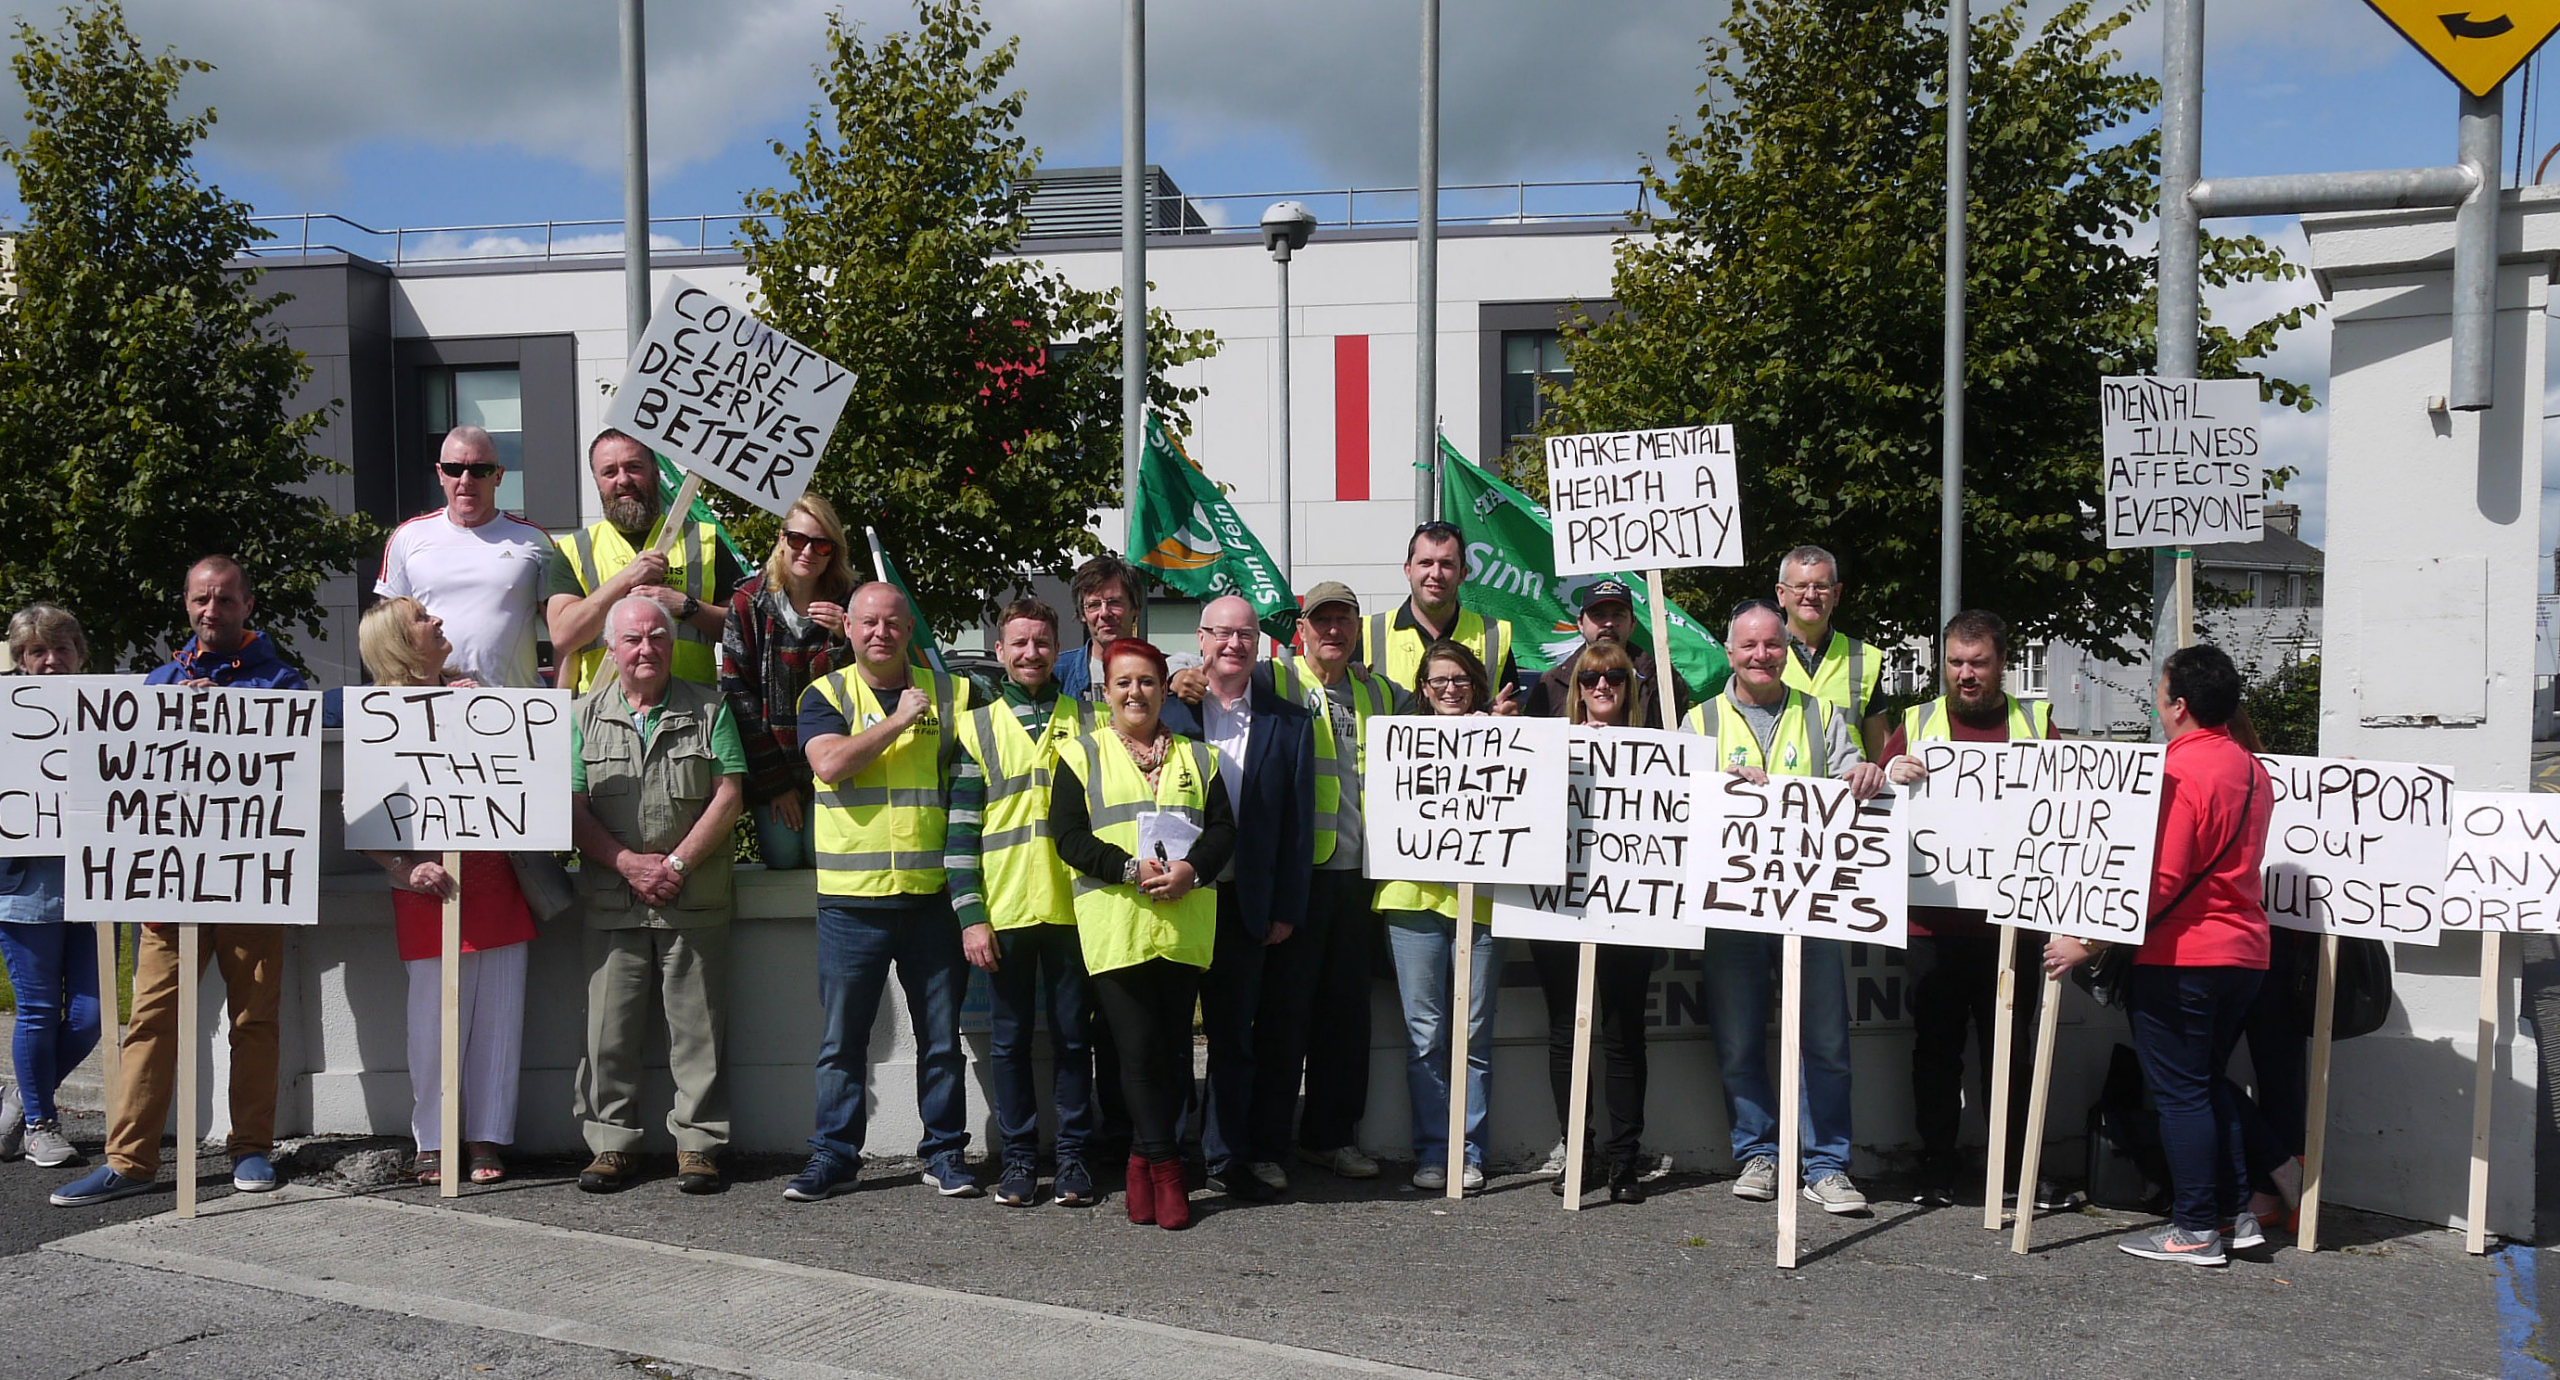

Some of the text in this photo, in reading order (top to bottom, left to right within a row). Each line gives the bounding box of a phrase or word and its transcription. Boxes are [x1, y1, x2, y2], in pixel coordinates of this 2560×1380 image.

[674, 287, 846, 394] COUNTY
[673, 327, 799, 406] CLARE
[638, 341, 820, 458] DESERVES
[2104, 377, 2215, 426] MENTAL
[633, 387, 794, 500] BETTER
[1551, 425, 1731, 469] MAKE MENTAL
[2130, 426, 2258, 458] ILLNESS
[1556, 465, 1717, 513] HEALTH A
[2108, 456, 2250, 492] AFFECTS
[1568, 503, 1733, 564] PRIORITY
[2114, 493, 2263, 537] EVERYONE
[1247, 556, 1280, 604] Sinn
[1464, 542, 1544, 600] Sinn
[77, 688, 318, 738] NO HEALTH
[361, 690, 558, 762] STOP
[99, 740, 296, 793] WITHOUT
[1386, 724, 1534, 762] MENTAL
[394, 751, 523, 786] THE
[1396, 763, 1527, 802] HEALTH
[2005, 742, 2159, 796] IMPROVE
[106, 788, 306, 841] MENTAL
[382, 791, 526, 842] PAIN
[1419, 794, 1515, 822] CAN'T
[1722, 776, 1894, 835] SAVE
[2028, 798, 2111, 841] OUR
[1397, 826, 1531, 868] WAIT
[1723, 820, 1891, 868] MINDS
[2013, 837, 2136, 882] ACTUE
[82, 846, 295, 905] HEALTH
[1721, 853, 1868, 891] SAVE
[2444, 851, 2560, 894] ANY
[1703, 881, 1888, 934] LIVES
[1992, 873, 2140, 933] SERVICES
